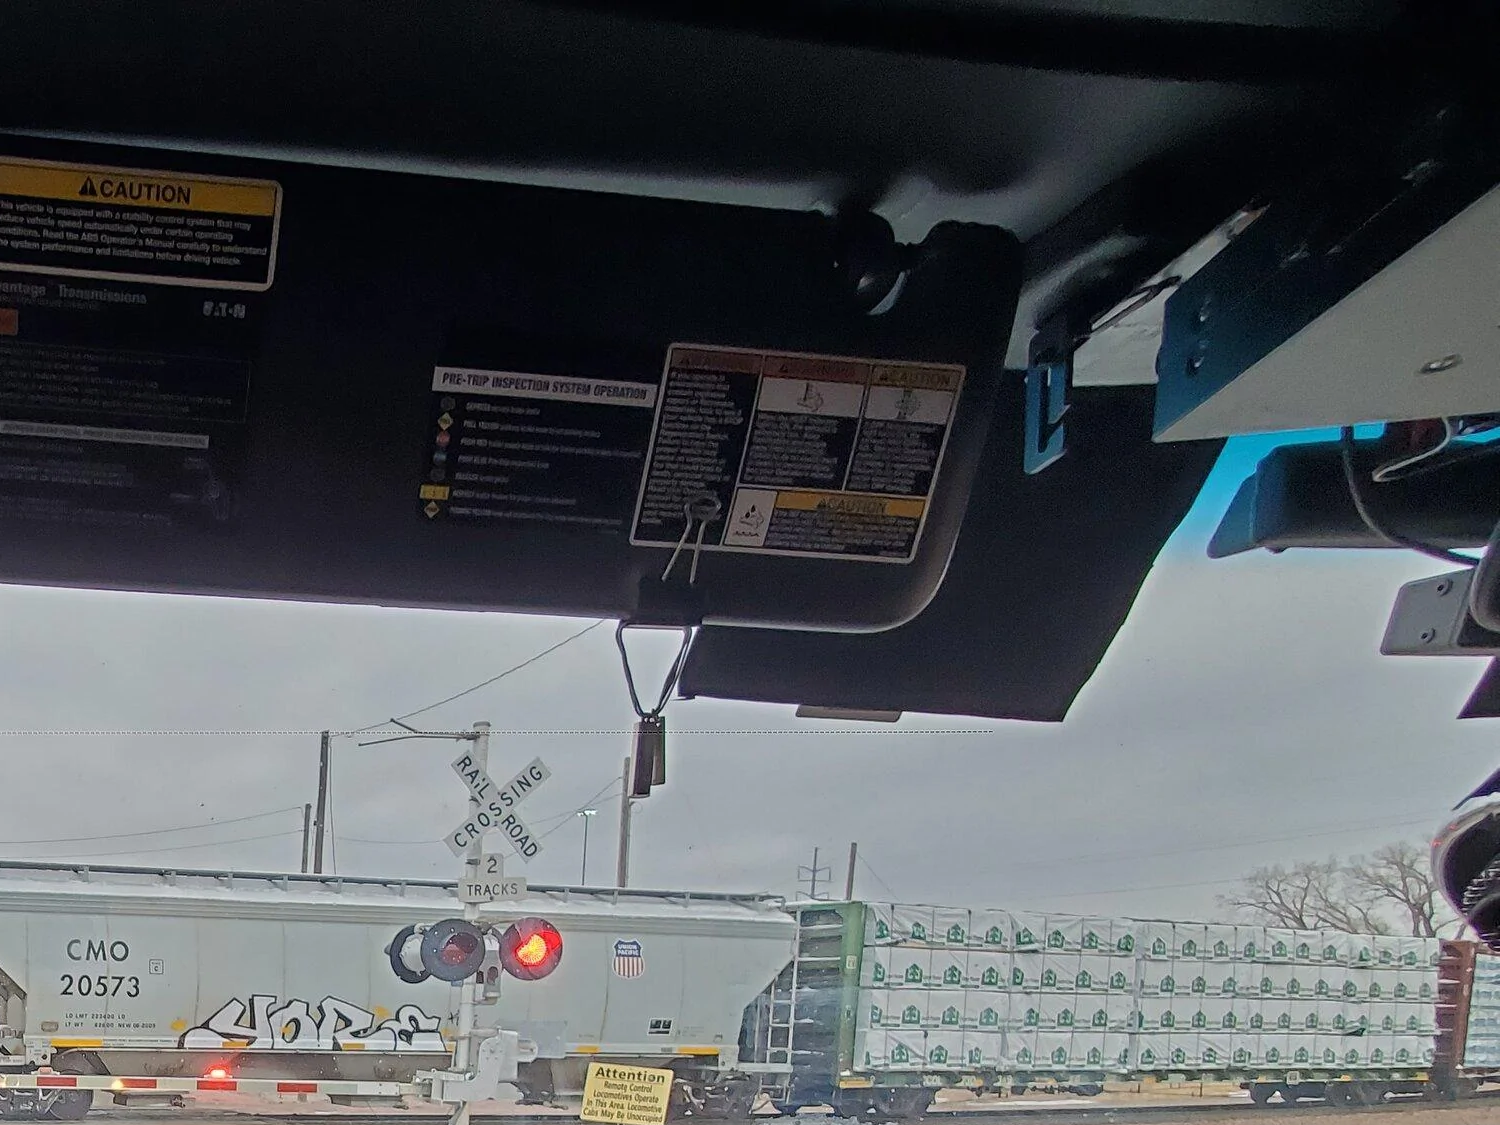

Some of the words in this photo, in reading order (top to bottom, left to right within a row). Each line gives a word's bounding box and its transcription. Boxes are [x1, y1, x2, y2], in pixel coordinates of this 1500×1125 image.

[100, 179, 192, 205] CAUTION
[442, 371, 490, 387] PRE-TRIP
[491, 375, 550, 392] INSPECTION
[552, 379, 591, 396] SYSTEM
[593, 383, 648, 401] OPERATION
[454, 765, 543, 848] CROSSING
[457, 756, 492, 799] RAIL
[501, 813, 538, 858] ROAD
[487, 856, 498, 874] 2
[467, 882, 518, 897] TRACKS
[66, 938, 130, 963] CMO
[616, 948, 640, 956] PACIFIC
[617, 943, 639, 951] UNION
[60, 974, 141, 999] 20573
[595, 1066, 665, 1083] Attention
[603, 1081, 628, 1092] Remote
[629, 1084, 653, 1093] Control
[593, 1090, 632, 1101] Locomotives
[634, 1093, 660, 1104] Operate
[586, 1098, 594, 1106] In
[595, 1098, 608, 1108] This
[627, 1103, 663, 1114] Locomotive
[583, 1107, 599, 1117] Cabs
[601, 1109, 615, 1120] May
[616, 1110, 625, 1119] Be
[626, 1112, 663, 1123] Unoccupied
